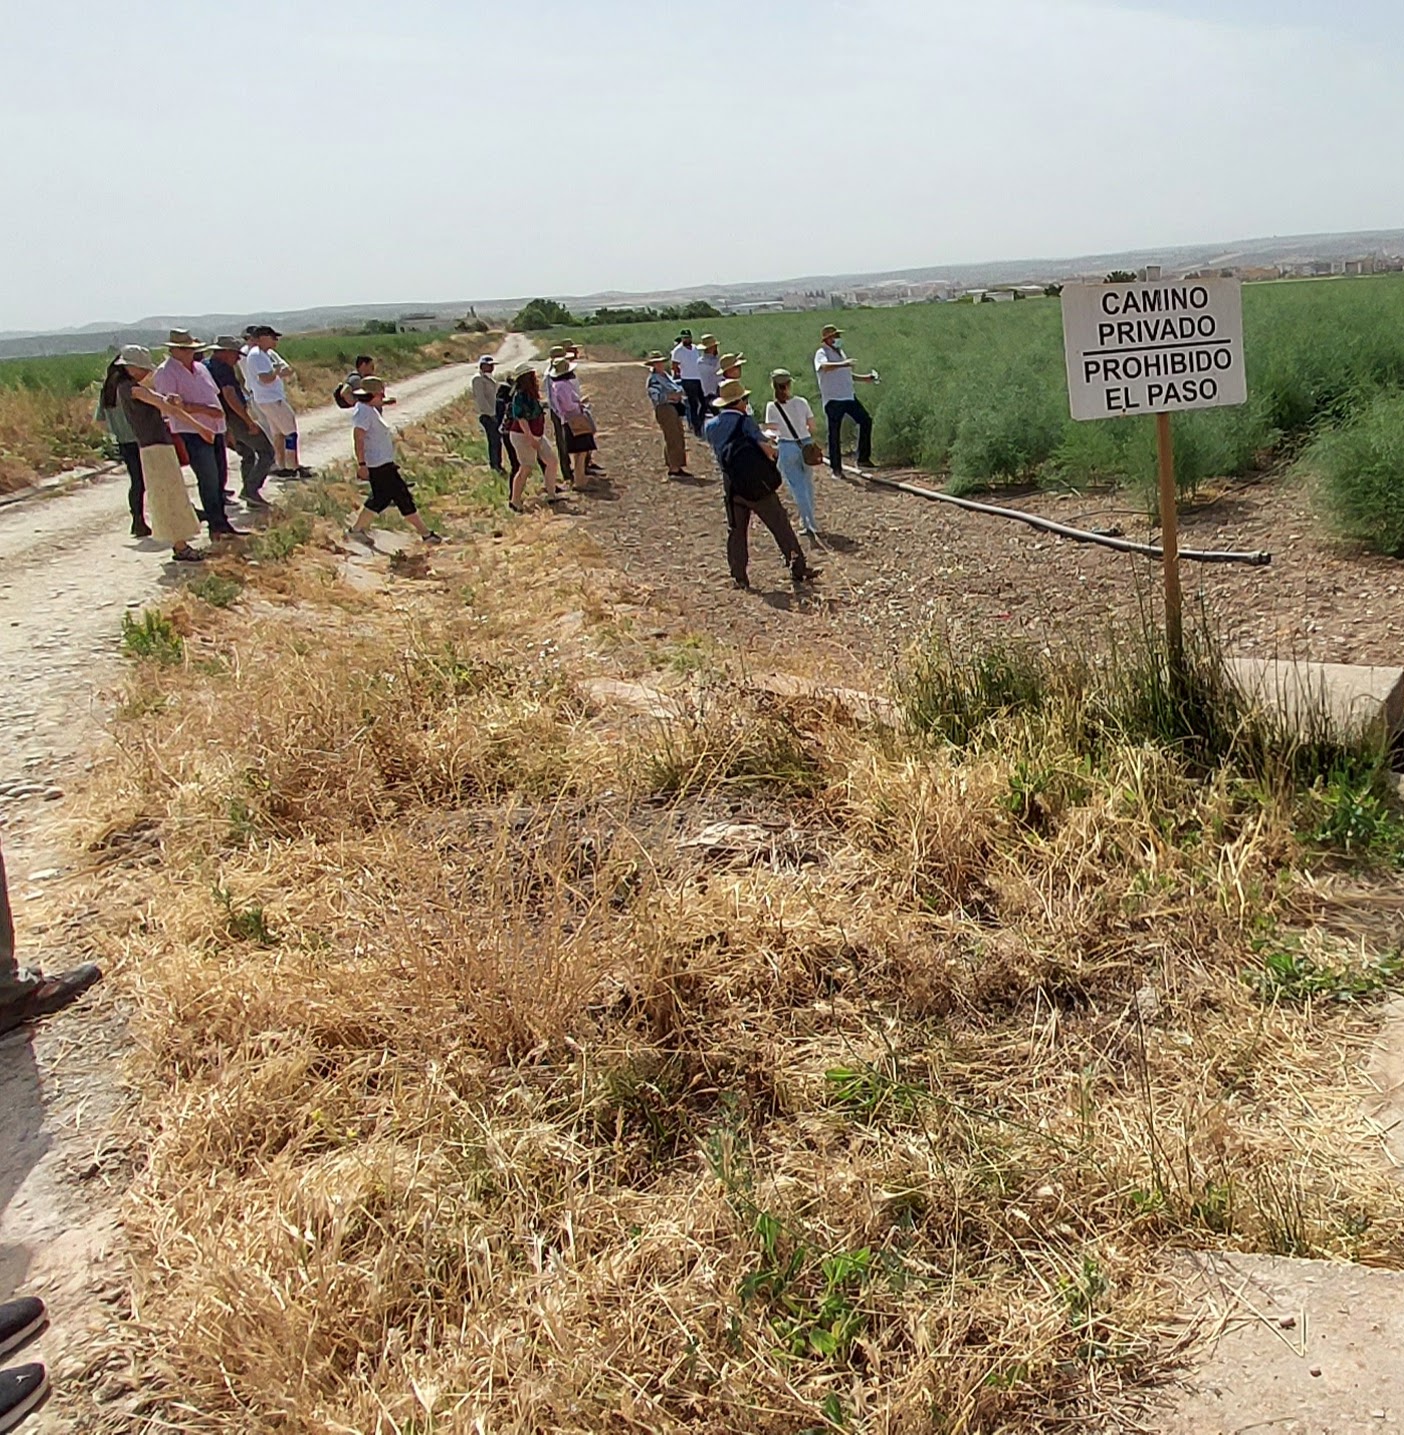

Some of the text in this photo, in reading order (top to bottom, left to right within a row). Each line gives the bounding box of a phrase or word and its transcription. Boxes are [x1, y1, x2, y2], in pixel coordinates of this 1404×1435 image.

[1102, 286, 1208, 315] CAMINO
[1098, 315, 1216, 346] PRIVADO
[1084, 348, 1232, 383] PROHIBIDO
[1106, 378, 1218, 411] EL PASO
